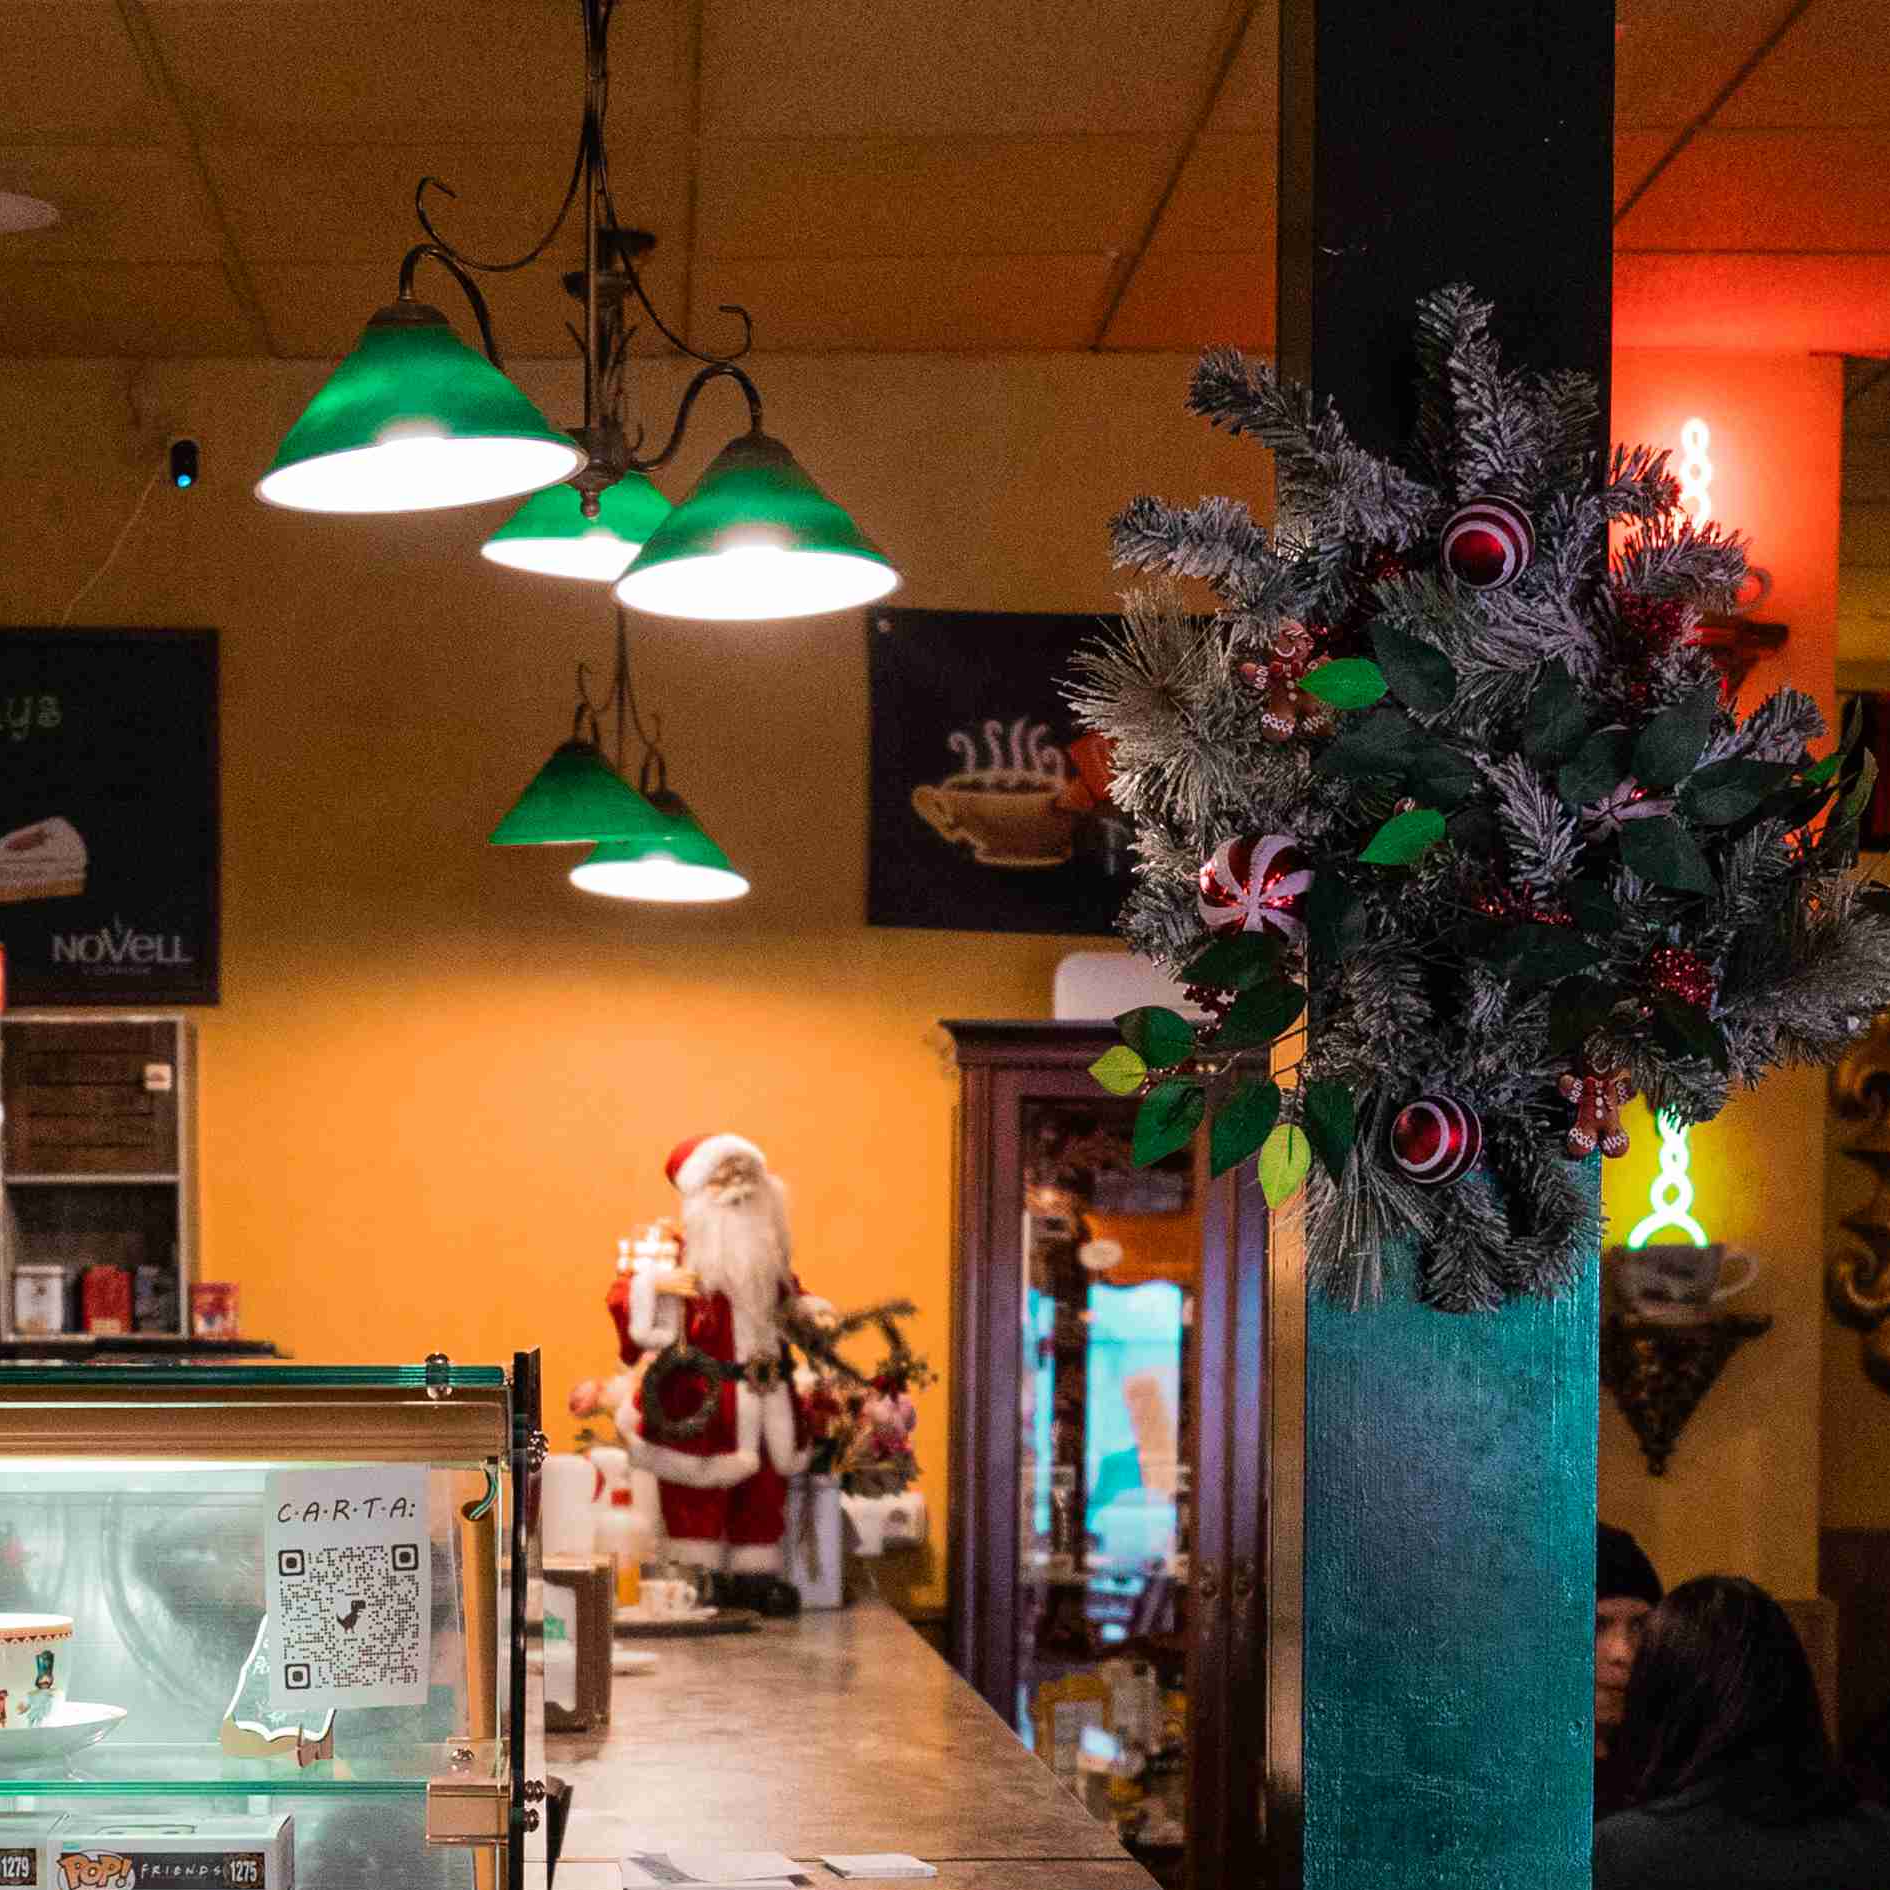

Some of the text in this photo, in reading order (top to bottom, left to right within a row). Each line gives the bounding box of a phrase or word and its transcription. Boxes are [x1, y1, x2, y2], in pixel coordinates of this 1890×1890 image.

[0, 1855, 31, 1879] 1279
[56, 1853, 258, 1890] POP! FRIENDS 1275
